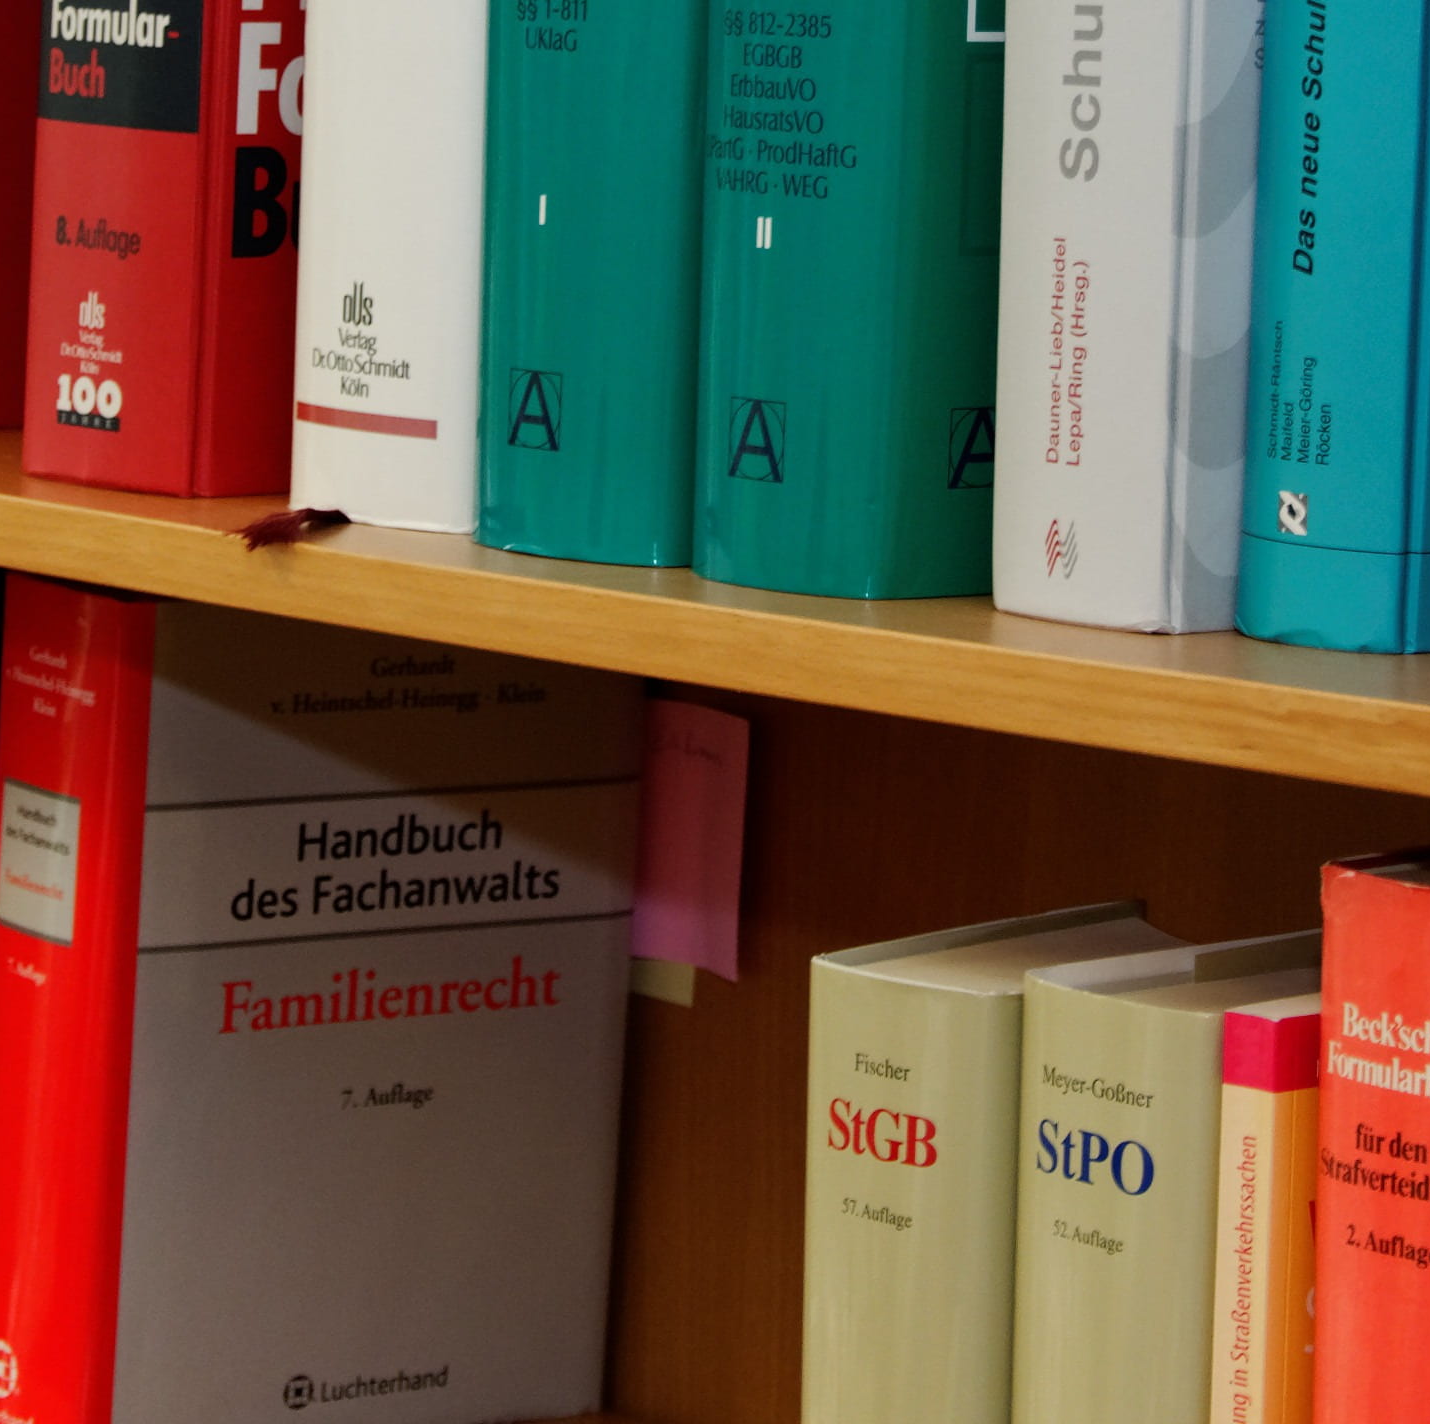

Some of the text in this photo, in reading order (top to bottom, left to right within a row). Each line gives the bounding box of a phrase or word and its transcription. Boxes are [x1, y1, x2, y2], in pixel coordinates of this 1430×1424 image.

[525, 28, 577, 52] UKlaG
[748, 12, 832, 40] 812-2385
[49, 47, 105, 98] Buch
[742, 42, 803, 70] EGBGB
[729, 73, 817, 103] ErbbauVO
[722, 104, 824, 135] HausratsVO
[757, 140, 857, 170] ProdHaftG
[1300, 112, 1321, 197] neue
[783, 173, 829, 200] WEG
[56, 215, 141, 260] 8. Auflage
[1293, 209, 1316, 275] Das
[338, 327, 377, 356] Verlag
[1045, 237, 1066, 465] Dauner-Lieb/Heidel
[1066, 259, 1090, 467] Lepa/Ring (Hrsg.)
[56, 374, 123, 418] 100
[341, 376, 369, 398] Köln
[1267, 320, 1283, 458] Schmidt-Räntsch
[1280, 402, 1294, 462] Maifeld
[1296, 356, 1318, 464] Meier-Göring
[1316, 403, 1332, 466] Röcken
[296, 811, 503, 863] Handbuch
[230, 861, 561, 922] des Fachanwalts
[219, 955, 562, 1035] Familienrecht
[854, 1052, 911, 1083] Fischer
[1042, 1063, 1155, 1110] Meyer-Goßner
[364, 1081, 434, 1112] Auflage
[827, 1096, 938, 1169] StGB
[1355, 1122, 1429, 1165] für den
[1036, 1118, 1155, 1197] StPO
[860, 1203, 914, 1233] Auflage
[1346, 1223, 1362, 1248] 2.
[1072, 1225, 1125, 1257] Auflage
[1230, 1134, 1259, 1364] Straßenverkehrssachen
[320, 1364, 450, 1403] Luchterhand
